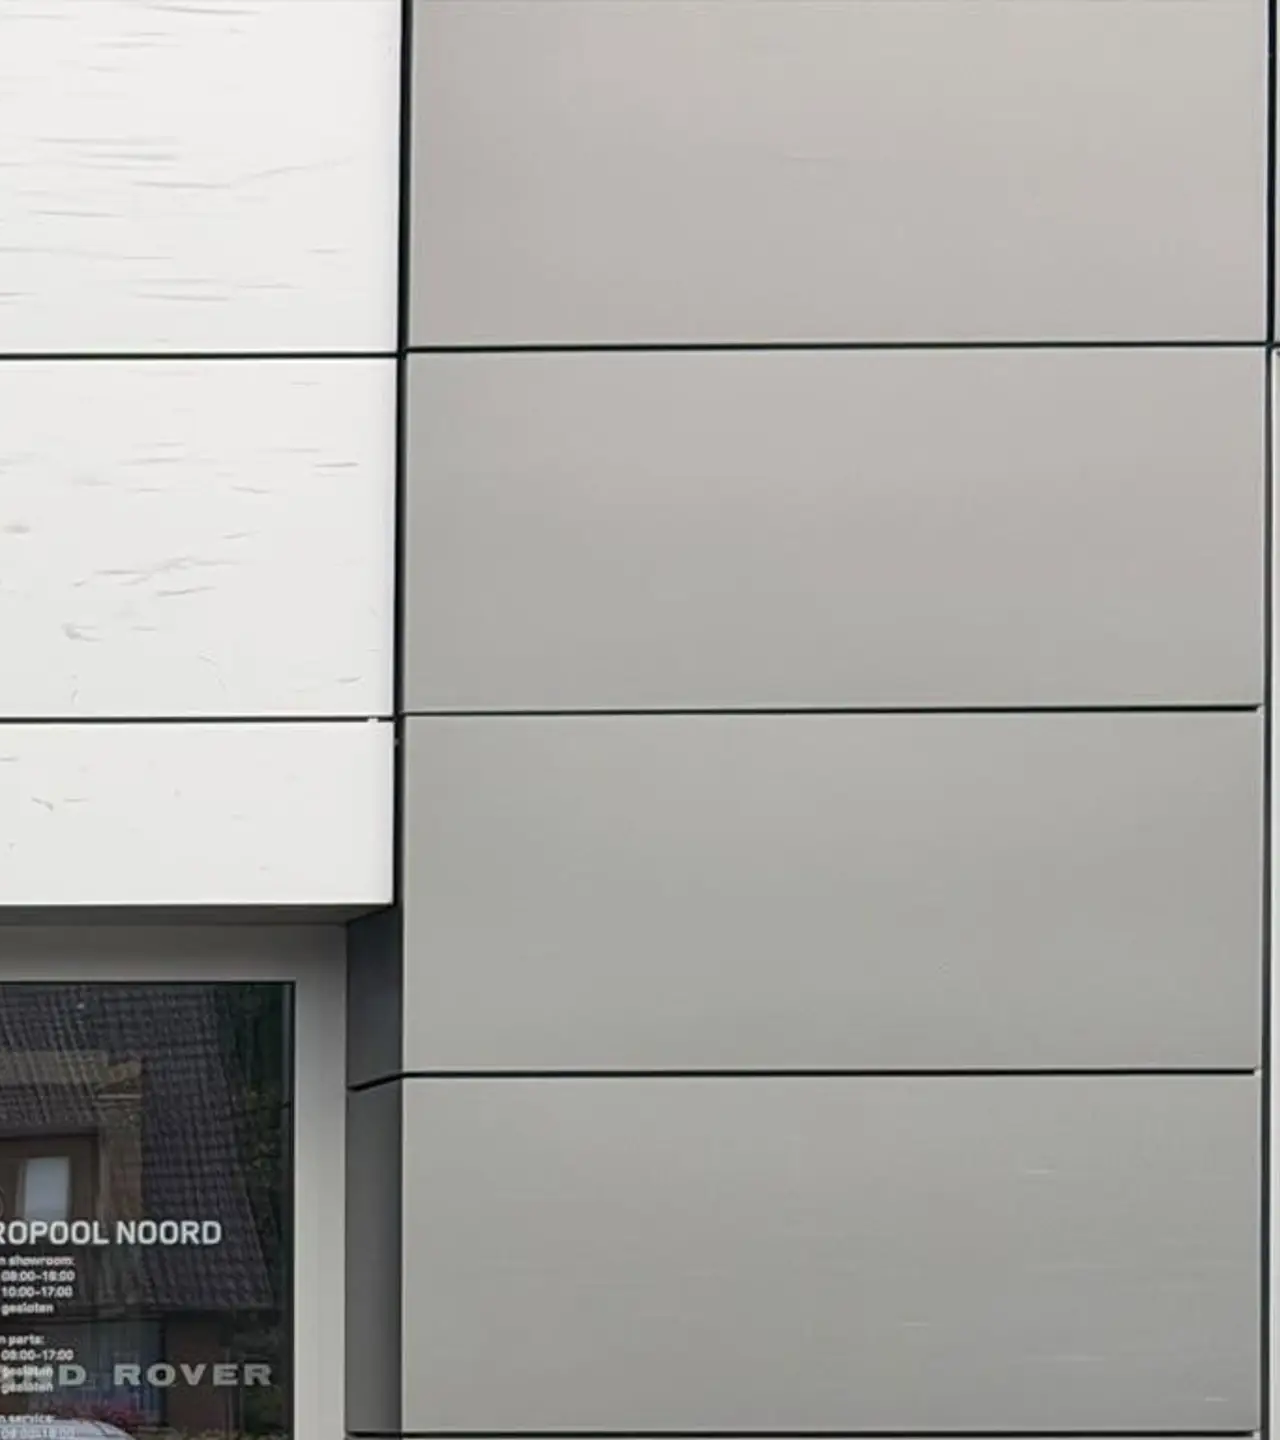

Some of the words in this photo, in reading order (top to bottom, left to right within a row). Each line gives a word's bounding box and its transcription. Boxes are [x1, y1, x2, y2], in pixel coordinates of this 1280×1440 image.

[116, 1220, 223, 1245] NOORD
[1, 1302, 54, 1317] gesloten
[114, 1363, 273, 1386] ROVER
